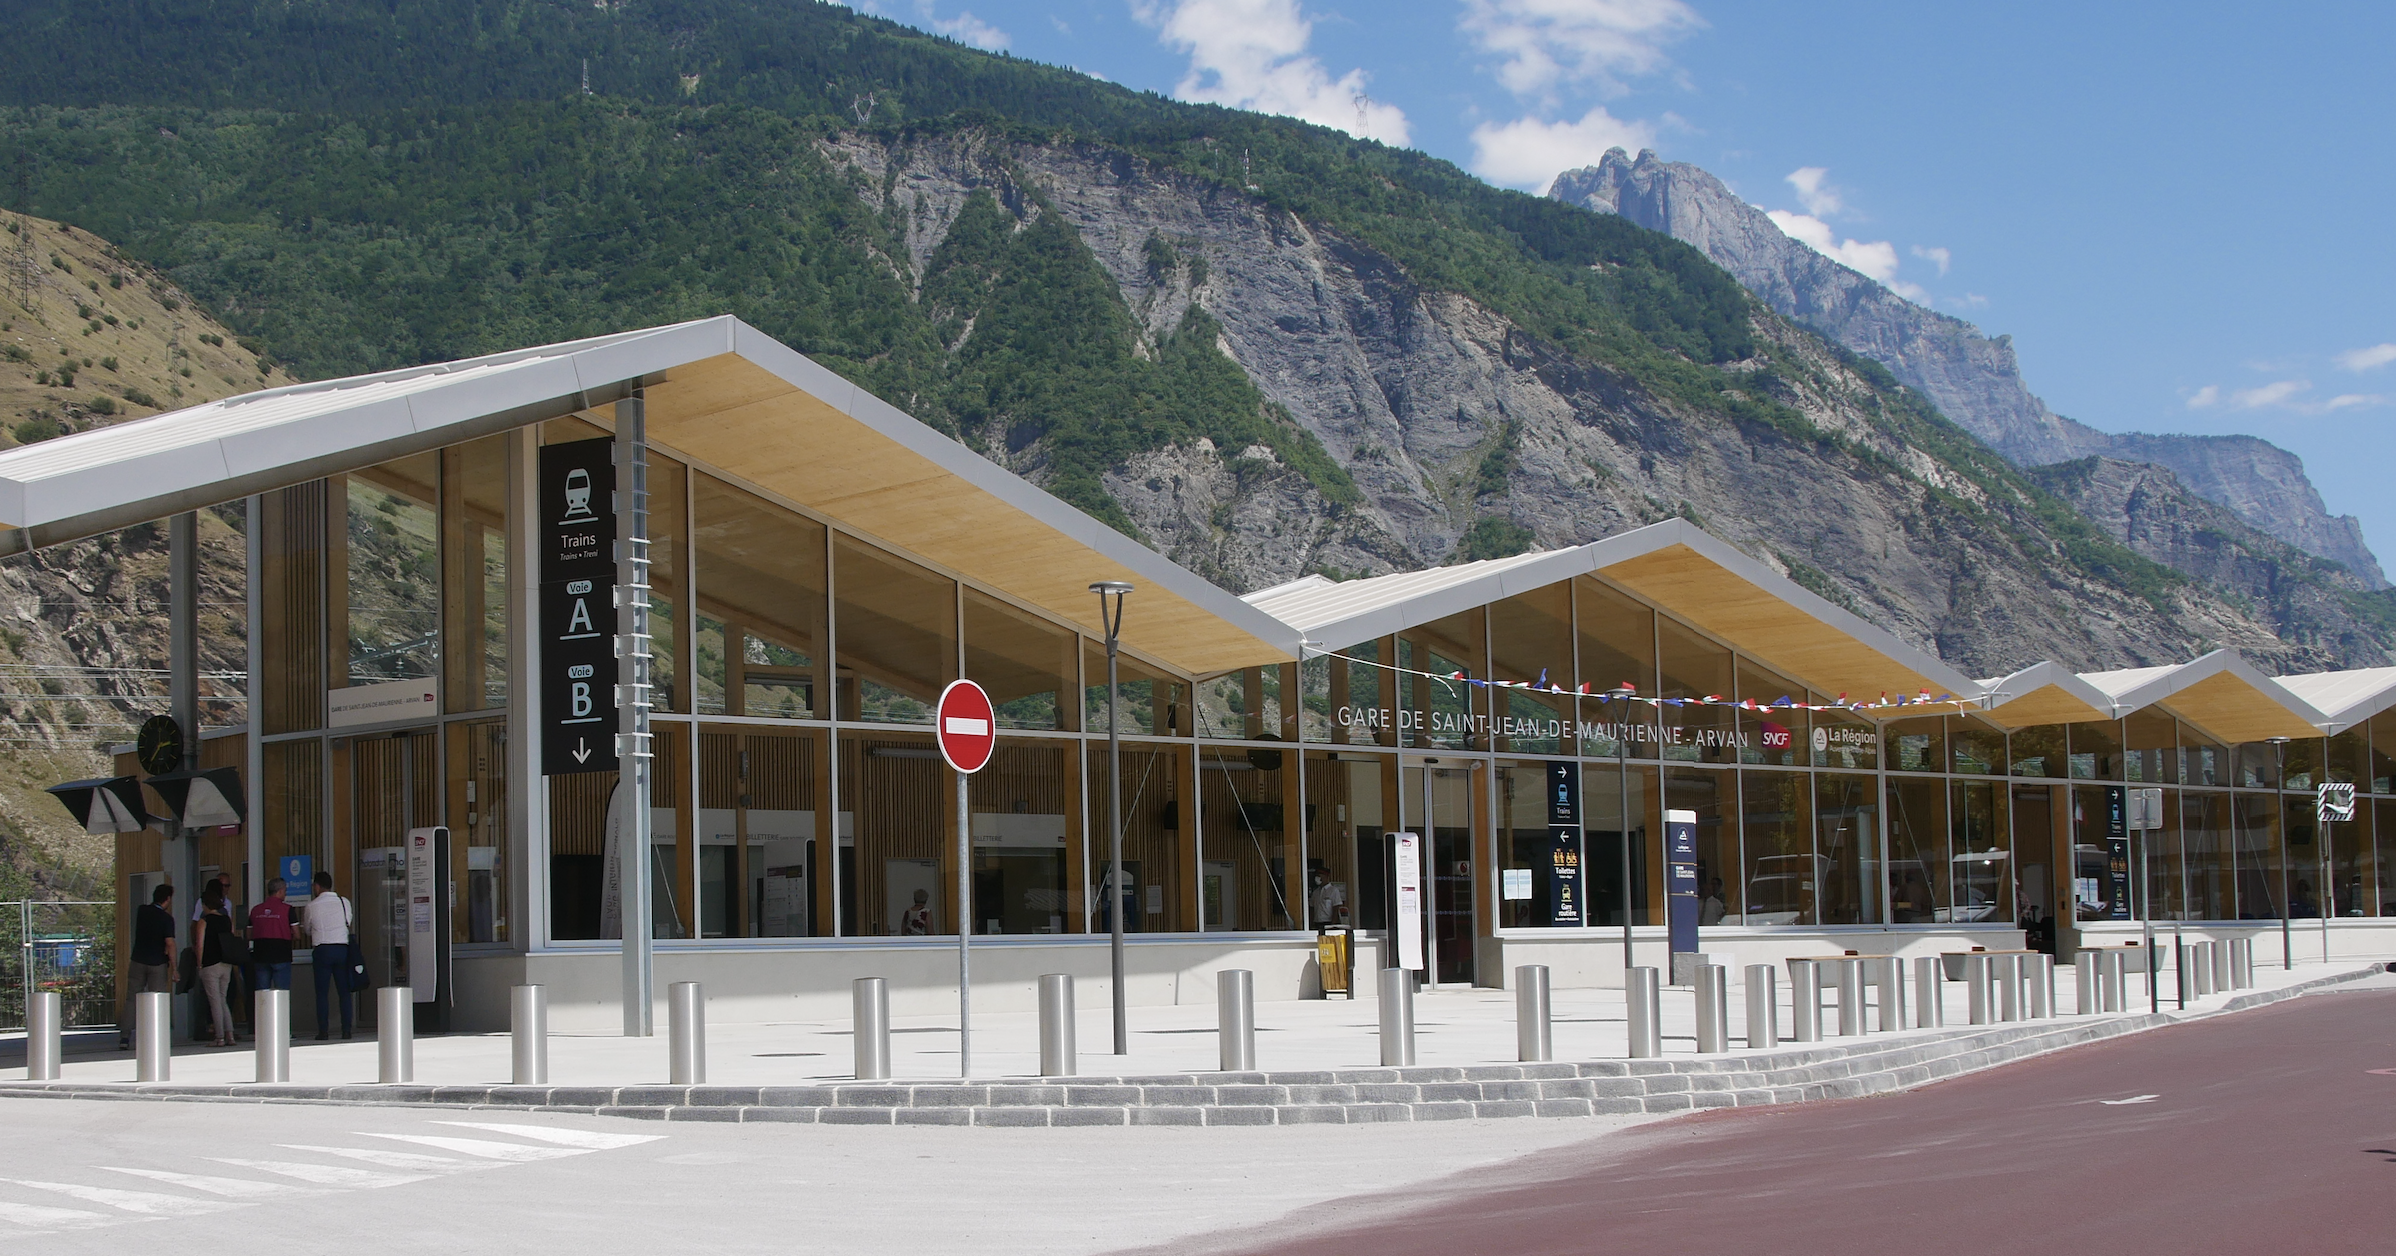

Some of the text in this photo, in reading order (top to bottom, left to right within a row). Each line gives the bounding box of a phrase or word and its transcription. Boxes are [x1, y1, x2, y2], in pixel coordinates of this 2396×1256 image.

[561, 533, 596, 548] Trains
[569, 582, 589, 593] Voie
[568, 598, 593, 633] A
[571, 666, 590, 677] Voie
[572, 682, 593, 717] B
[1338, 706, 1391, 729] GARE
[1400, 710, 1424, 730] DE
[1695, 729, 1749, 749] ARVAN
[1762, 731, 1789, 746] SNCF
[1828, 728, 1877, 746] La Région
